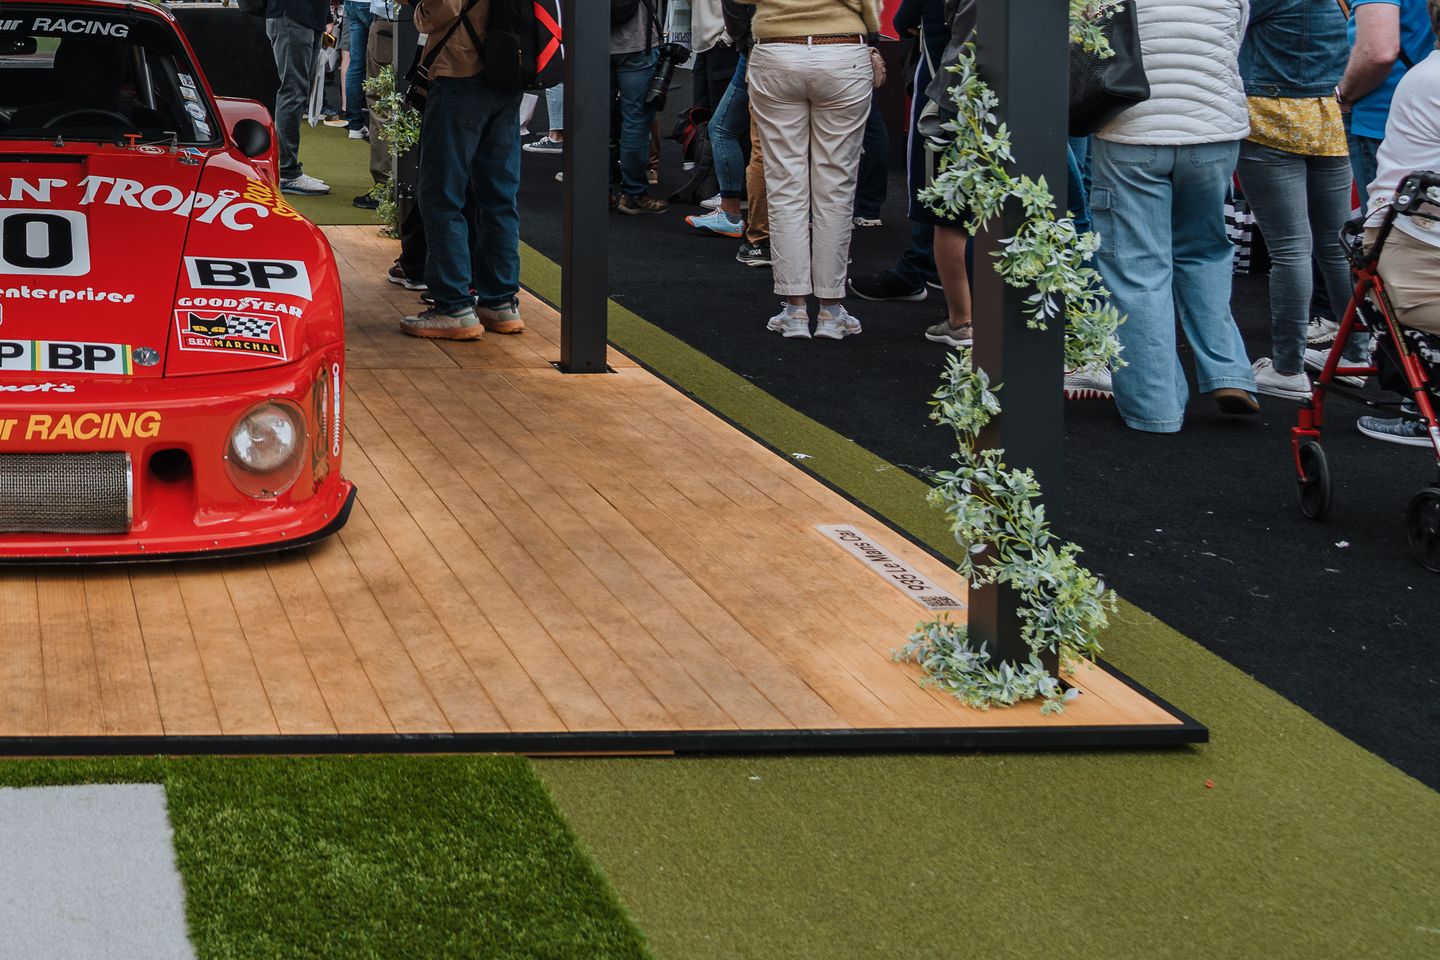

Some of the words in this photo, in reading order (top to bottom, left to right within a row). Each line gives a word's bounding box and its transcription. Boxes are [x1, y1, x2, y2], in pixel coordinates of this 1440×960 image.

[32, 18, 129, 38] RACING
[77, 175, 269, 231] TROPIC
[195, 259, 298, 289] BP
[48, 343, 116, 370] BP
[214, 340, 278, 353] MARCHAL
[25, 410, 162, 440] RACING
[834, 528, 862, 542] Car
[854, 542, 892, 562] Mans
[884, 561, 907, 574] Le
[892, 573, 932, 591] 935
